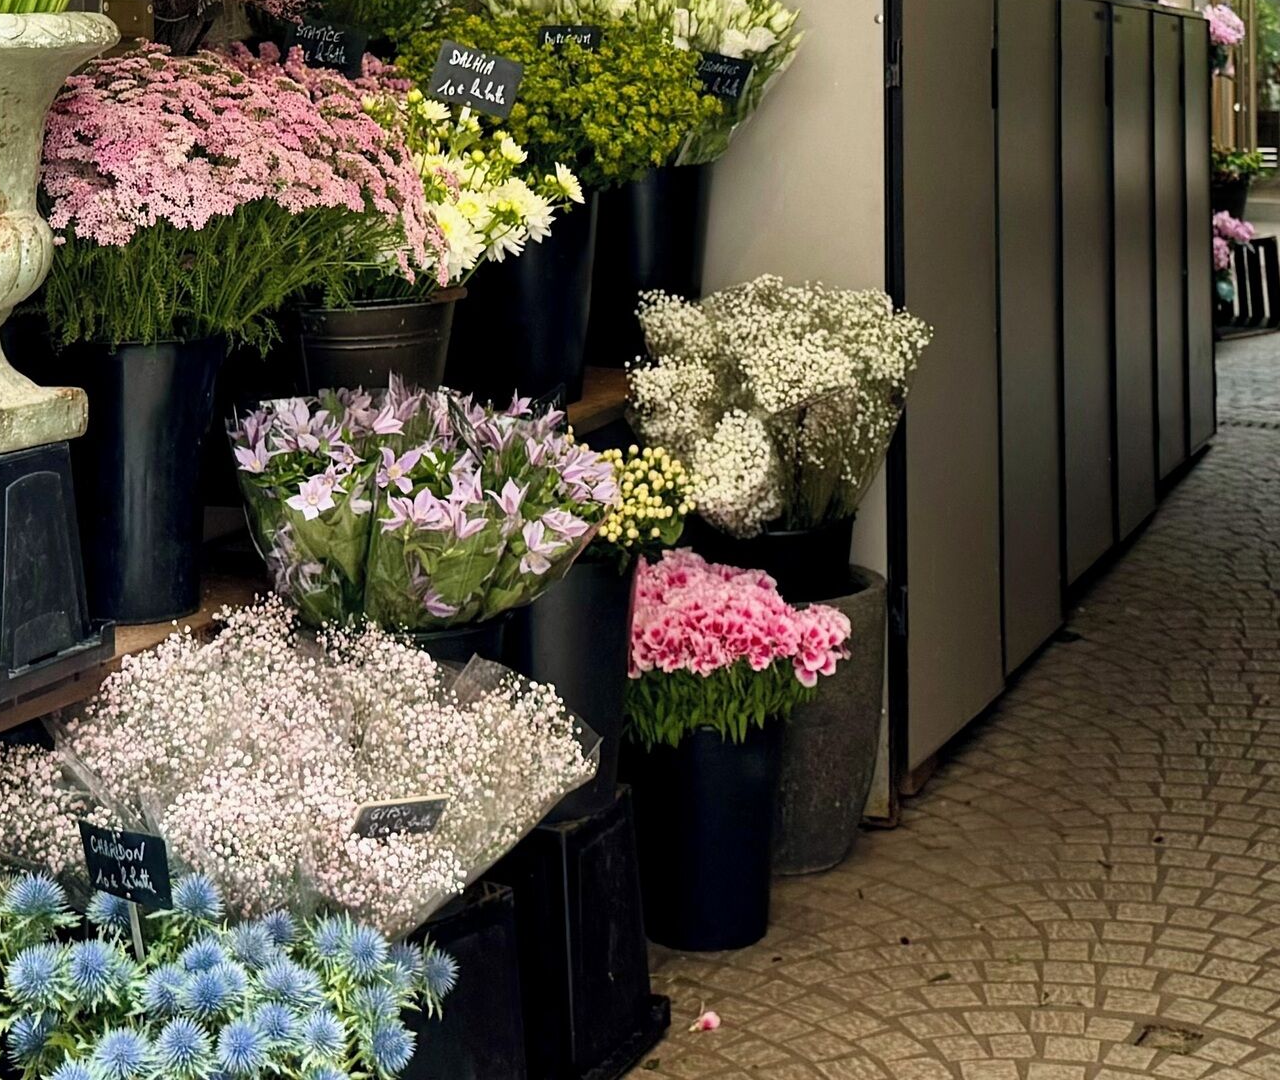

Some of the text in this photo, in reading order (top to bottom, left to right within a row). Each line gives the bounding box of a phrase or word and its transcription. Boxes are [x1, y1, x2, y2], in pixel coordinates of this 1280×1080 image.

[295, 24, 345, 43] STATICE
[449, 49, 496, 76] DALHIA
[90, 834, 146, 862] CHARDON
